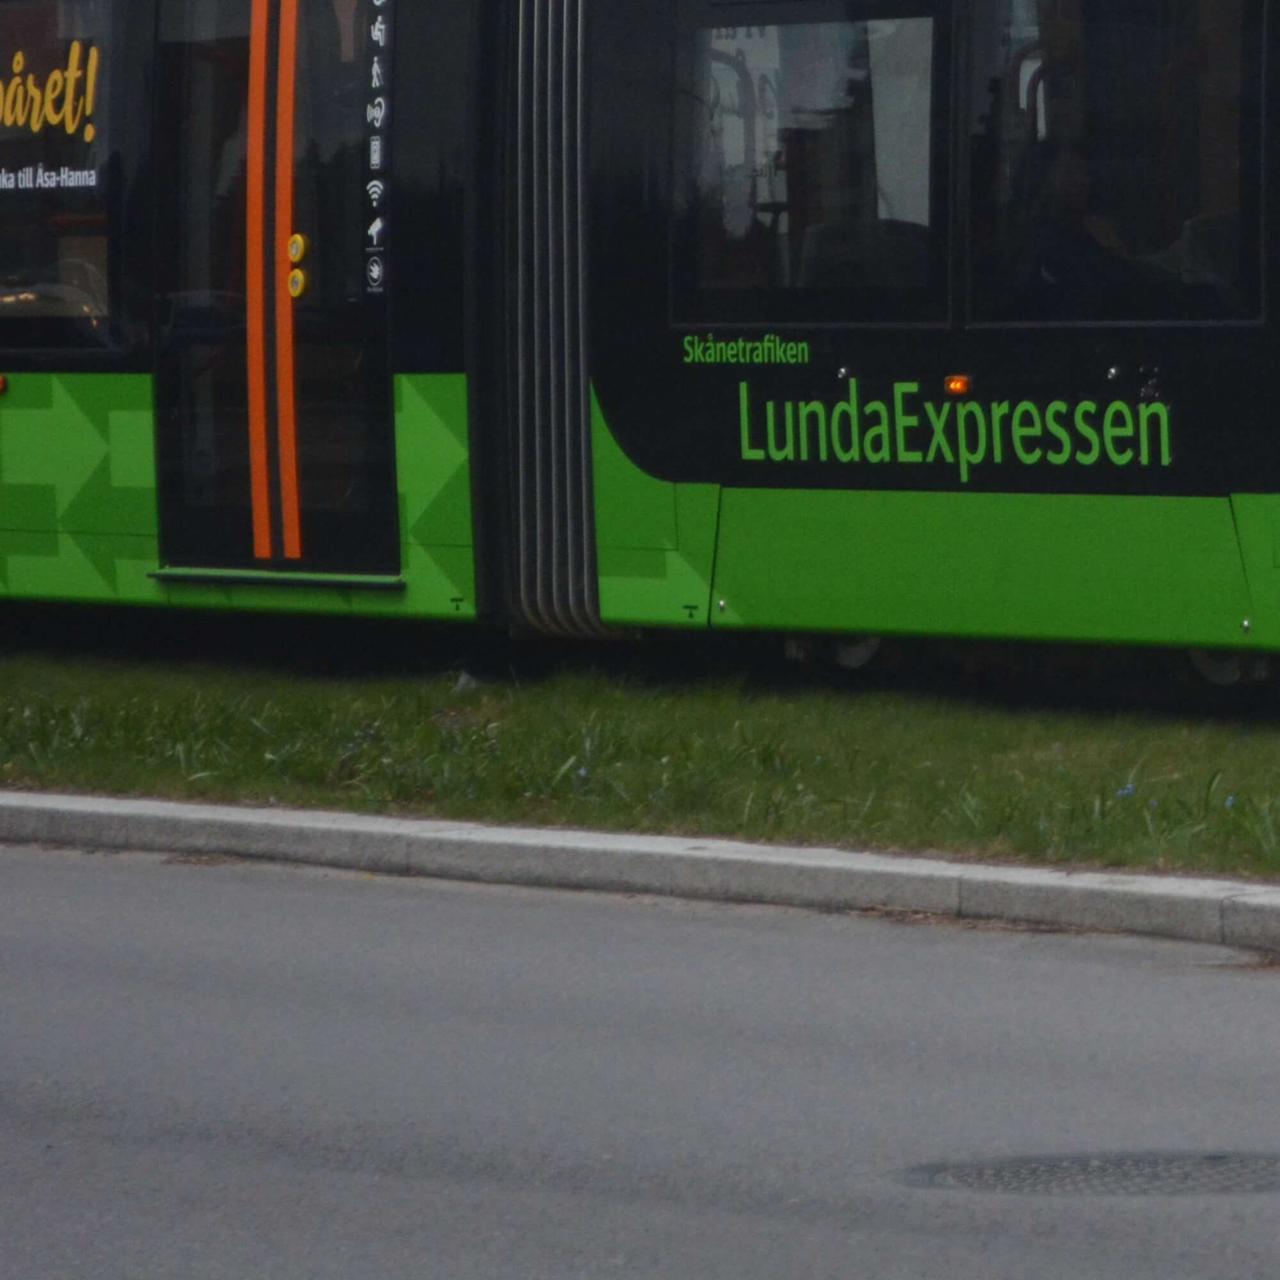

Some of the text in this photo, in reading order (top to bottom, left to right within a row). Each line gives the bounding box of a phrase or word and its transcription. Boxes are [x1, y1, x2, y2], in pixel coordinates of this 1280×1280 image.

[0, 40, 98, 143] året!
[17, 166, 34, 189] till
[35, 163, 97, 189] Åsa-Hanna
[683, 333, 809, 364] Skånetrafiken
[738, 377, 1173, 483] LundaExpressen
